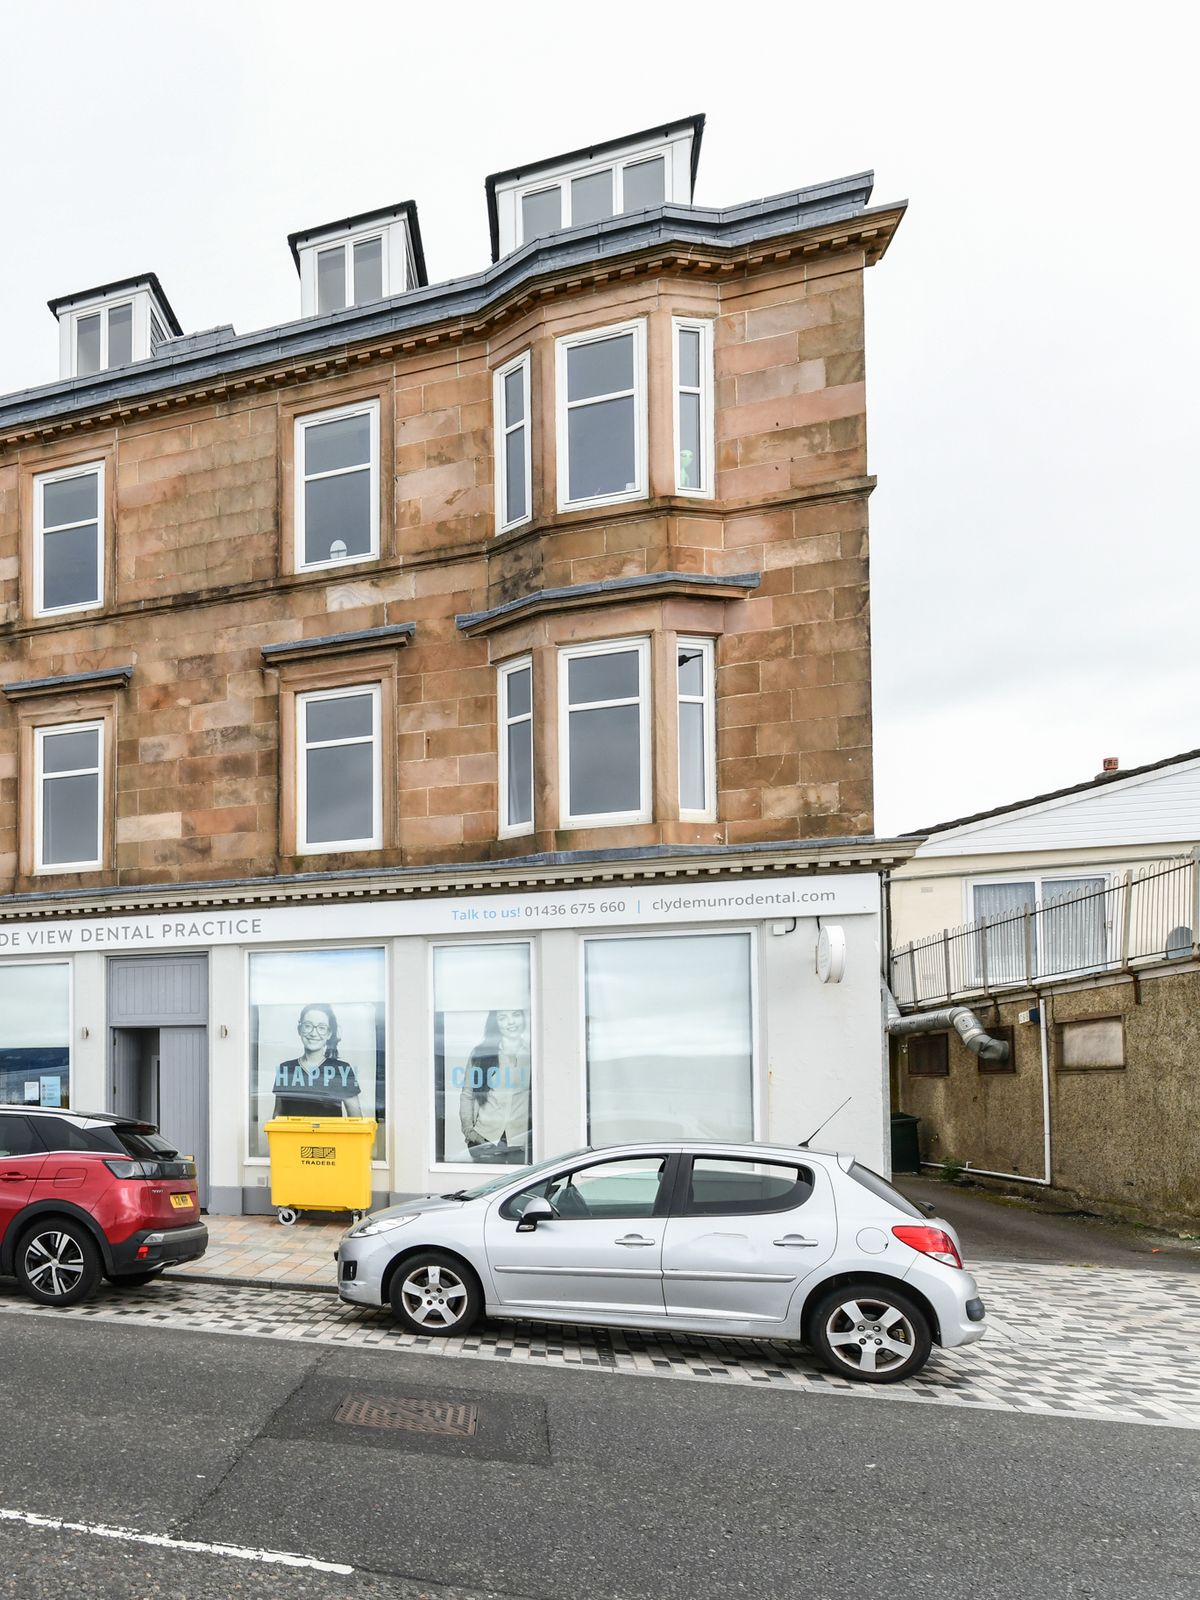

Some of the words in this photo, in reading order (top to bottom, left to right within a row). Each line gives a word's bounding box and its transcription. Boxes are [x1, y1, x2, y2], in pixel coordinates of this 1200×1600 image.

[451, 908, 479, 920] Talk
[483, 909, 497, 919] to
[501, 906, 521, 918] us!
[524, 904, 566, 917] 01436
[570, 902, 596, 915] 675
[600, 901, 626, 913] 660
[652, 891, 836, 912] clydemunrodental.com
[27, 929, 73, 944] VIEW
[81, 925, 154, 942] DENTAL
[162, 918, 262, 938] PRACTICE
[275, 1065, 359, 1087] HAPPY!
